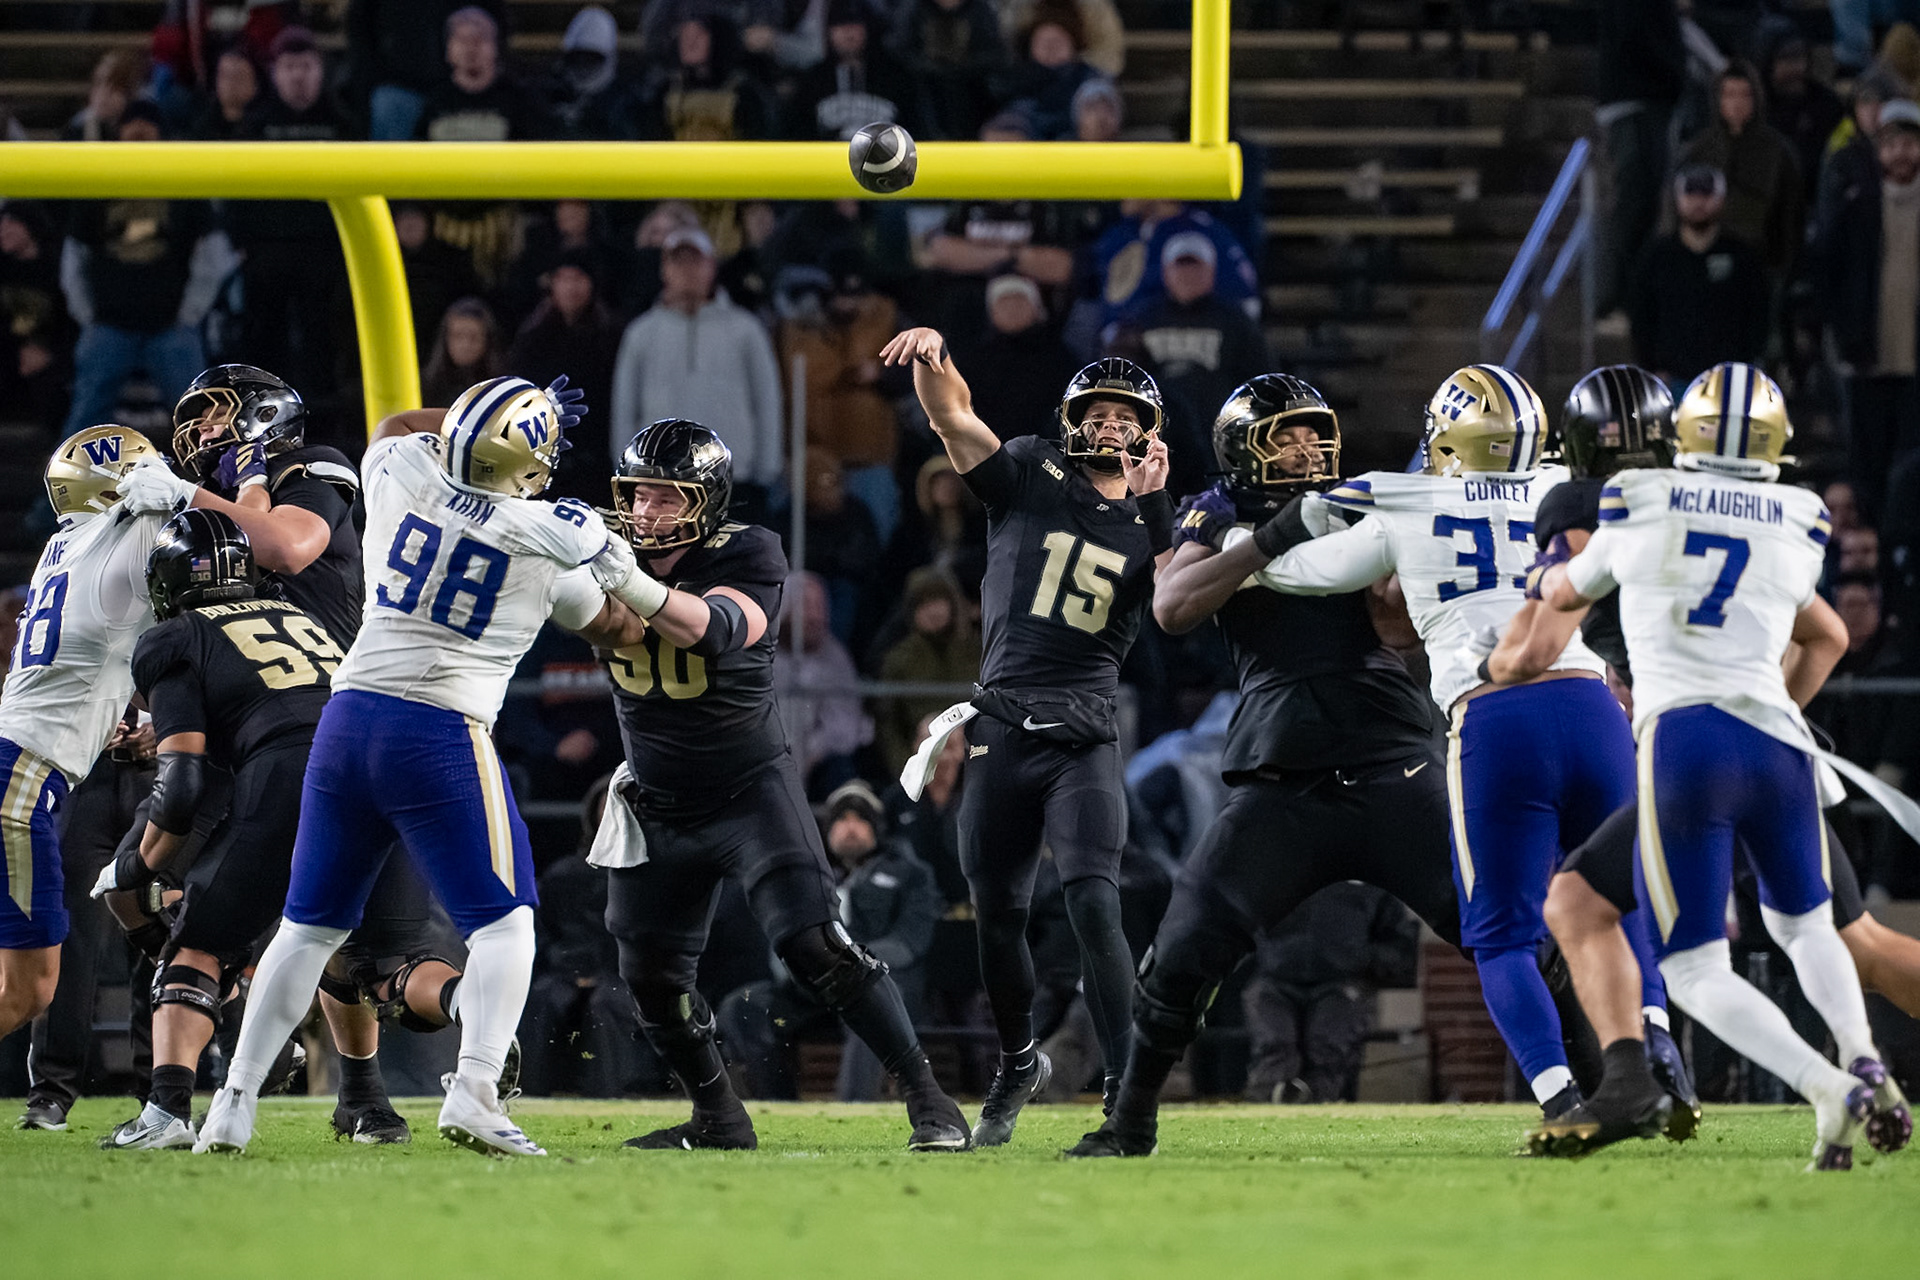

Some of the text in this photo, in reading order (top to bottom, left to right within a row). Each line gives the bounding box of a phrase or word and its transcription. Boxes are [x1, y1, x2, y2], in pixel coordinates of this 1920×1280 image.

[81, 436, 123, 466] W
[517, 411, 549, 451] W
[445, 492, 496, 526] KHAN
[1669, 486, 1783, 525] McLAUGHLIN
[376, 512, 511, 641] 98
[1029, 530, 1129, 635] 15
[1683, 530, 1751, 628] 7
[221, 615, 347, 690] 59
